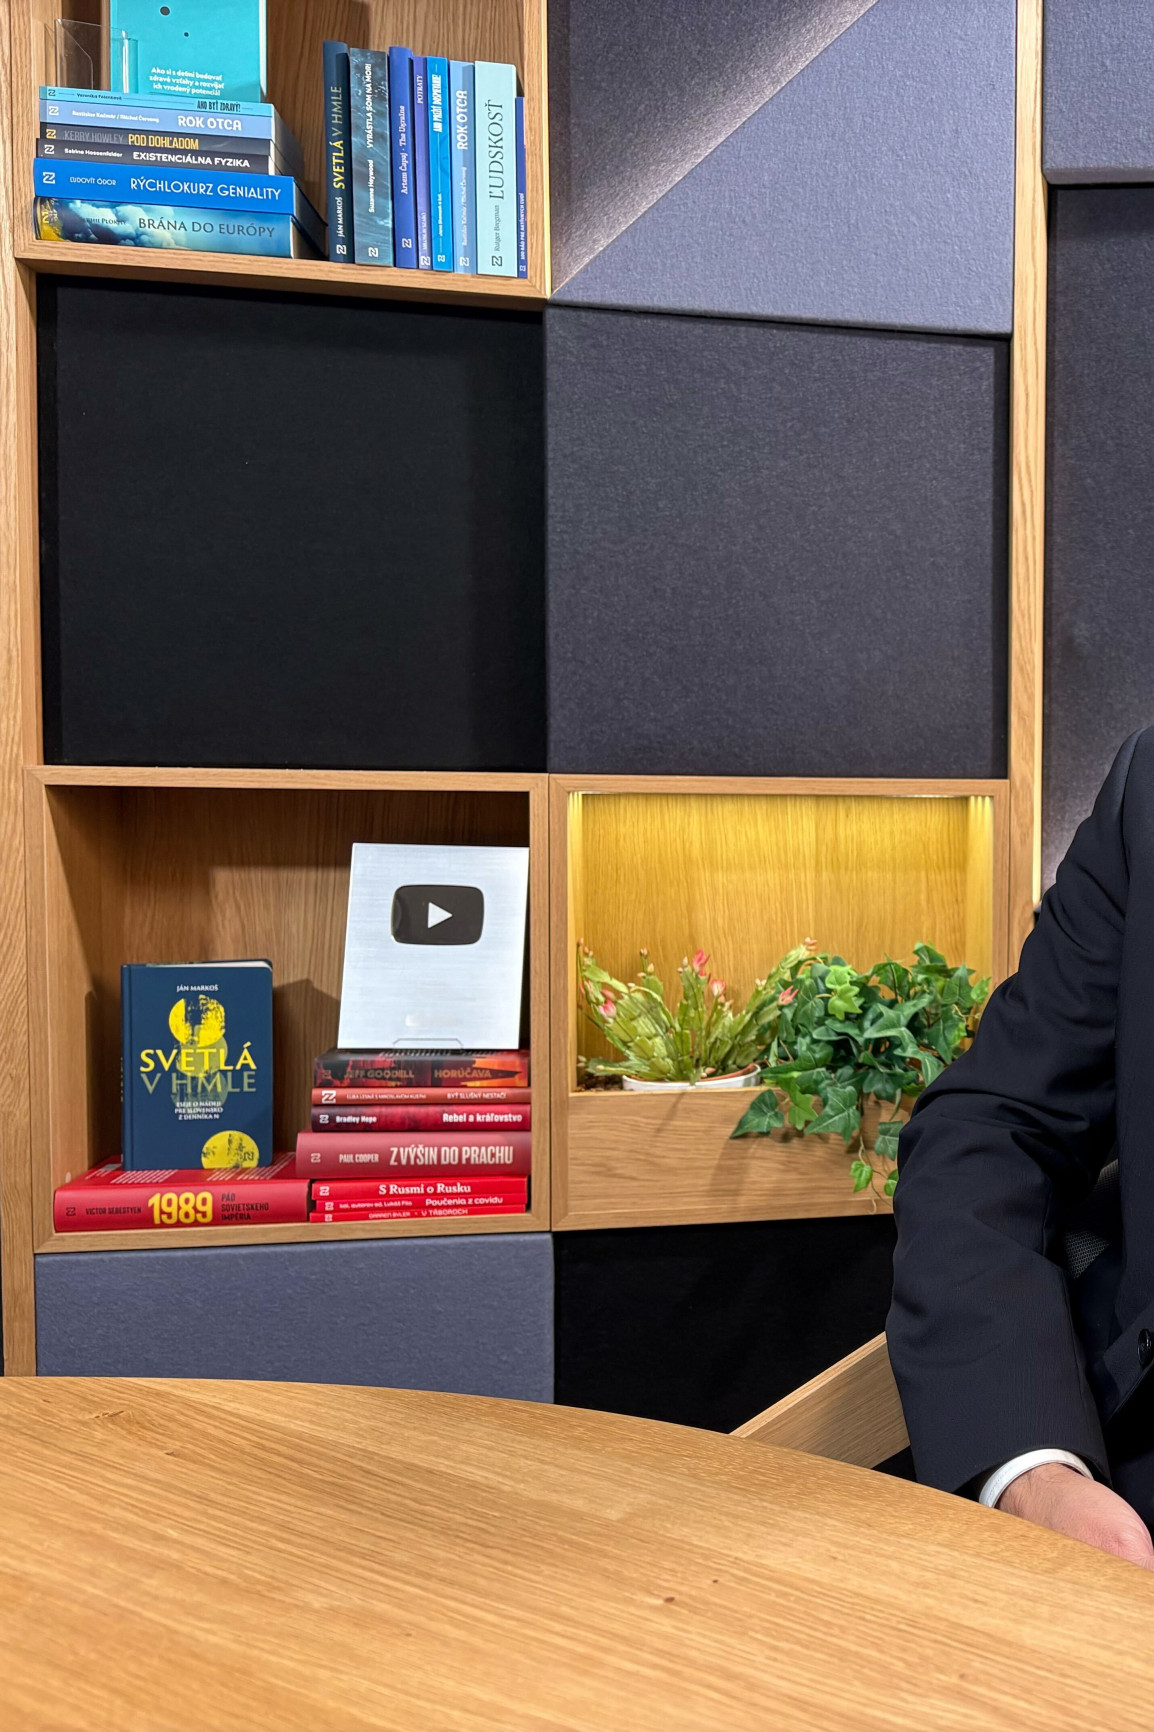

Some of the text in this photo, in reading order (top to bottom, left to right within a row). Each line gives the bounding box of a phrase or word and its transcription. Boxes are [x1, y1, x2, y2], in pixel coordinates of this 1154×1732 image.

[163, 84, 190, 94] vrodený
[366, 82, 372, 94] NA
[178, 115, 205, 129] ROK
[210, 117, 242, 131] OTCA
[456, 90, 468, 150] ROK OTCA
[329, 86, 345, 189] SVETLÁ V HMLE
[365, 113, 373, 148] VYRÁSTLA
[64, 130, 199, 150] KERRY HOWLEY POD DOHĽADOM
[484, 100, 504, 200] ĽUDSKOSŤ
[133, 151, 212, 165] EXISTENCIÁLNA
[215, 157, 250, 168] FYZIKA
[96, 177, 117, 186] ÓDOR
[130, 177, 214, 196] RÝCHLOKURZ
[217, 184, 281, 200] GENIALITY
[335, 196, 345, 237] JÁN MARKOŠ
[138, 215, 187, 232] BRÁNA
[191, 222, 214, 233] DO
[218, 222, 275, 237] EURÓPY
[177, 984, 189, 992] JÁN
[140, 1041, 257, 1072] SVETLÁ
[367, 1070, 415, 1078] GOODELL
[434, 1068, 492, 1078] HORÚČAVA
[141, 1073, 161, 1094] V
[171, 1071, 256, 1093] HMLE
[443, 1114, 467, 1123] Rebel
[476, 1113, 522, 1122] kráľovstvo
[339, 1154, 354, 1163] PAUL
[355, 1154, 379, 1163] COOPER
[390, 1148, 398, 1166] Z
[400, 1144, 437, 1166] VÝŠIN
[441, 1147, 458, 1165] DO
[462, 1146, 513, 1165] PRACHU
[221, 1192, 236, 1202] PÁD
[379, 1184, 386, 1195] S
[389, 1184, 424, 1194] Rusmi
[437, 1182, 471, 1194] Rusku
[85, 1207, 106, 1216] VICTOR
[107, 1206, 142, 1214] SEBESTYEN
[148, 1192, 213, 1225] 1989
[221, 1203, 269, 1212] SOVIETSKEHO
[426, 1197, 466, 1206] Poučenia
[221, 1212, 251, 1221] IMPÉRIA
